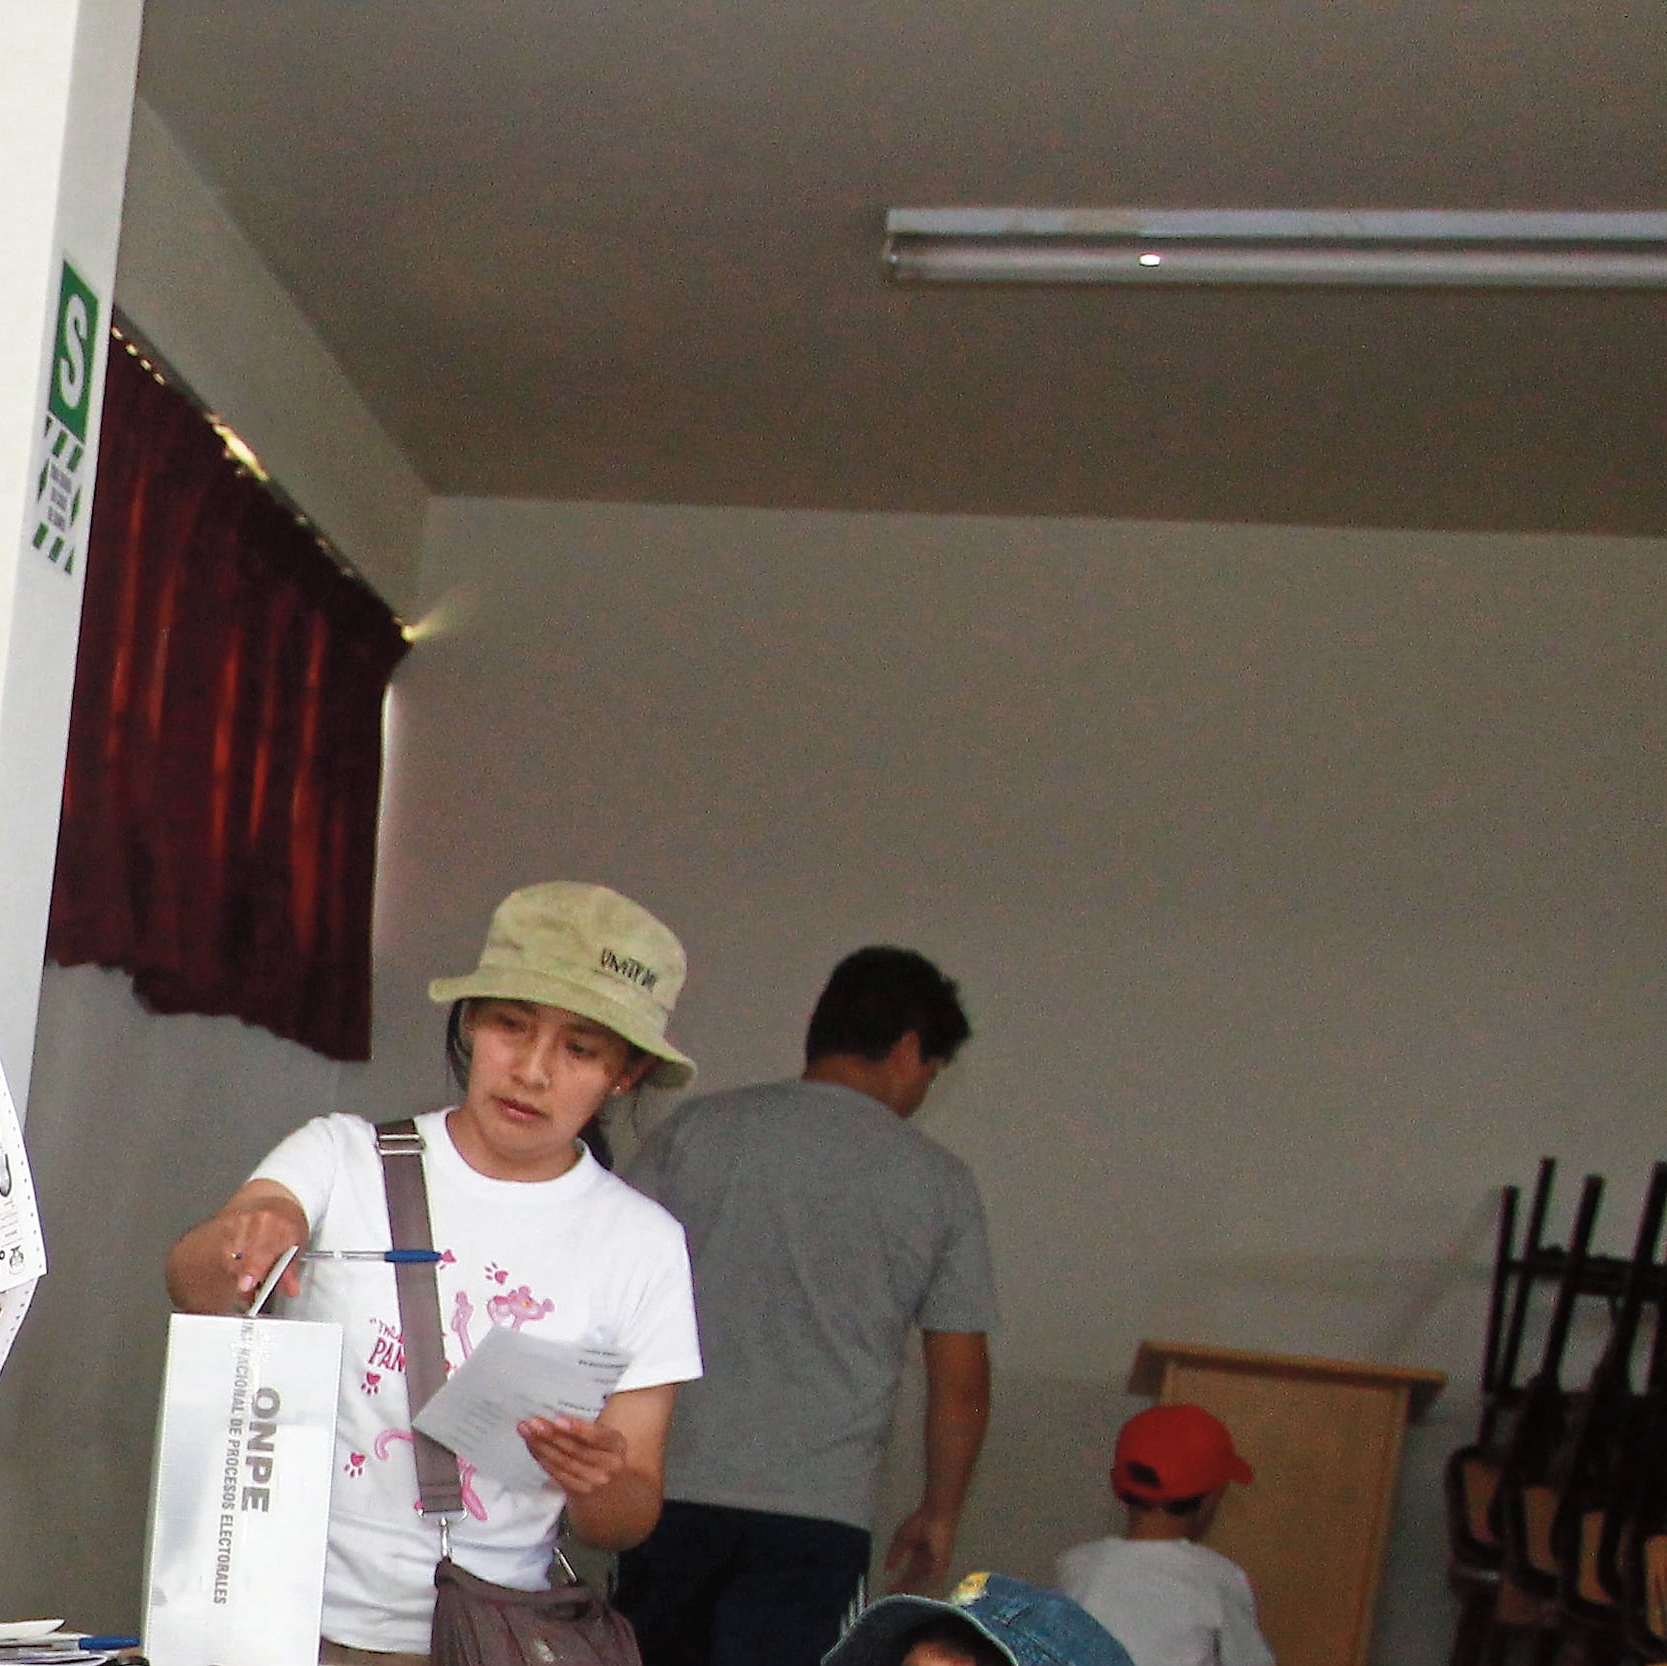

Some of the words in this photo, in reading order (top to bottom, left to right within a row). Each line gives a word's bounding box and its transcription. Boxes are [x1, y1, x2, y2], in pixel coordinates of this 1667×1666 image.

[59, 293, 88, 408] S
[229, 1417, 243, 1435] DE
[241, 1386, 281, 1513] ONPE
[220, 1438, 241, 1509] PROCESOS
[213, 1513, 235, 1606] ELECTORALES
